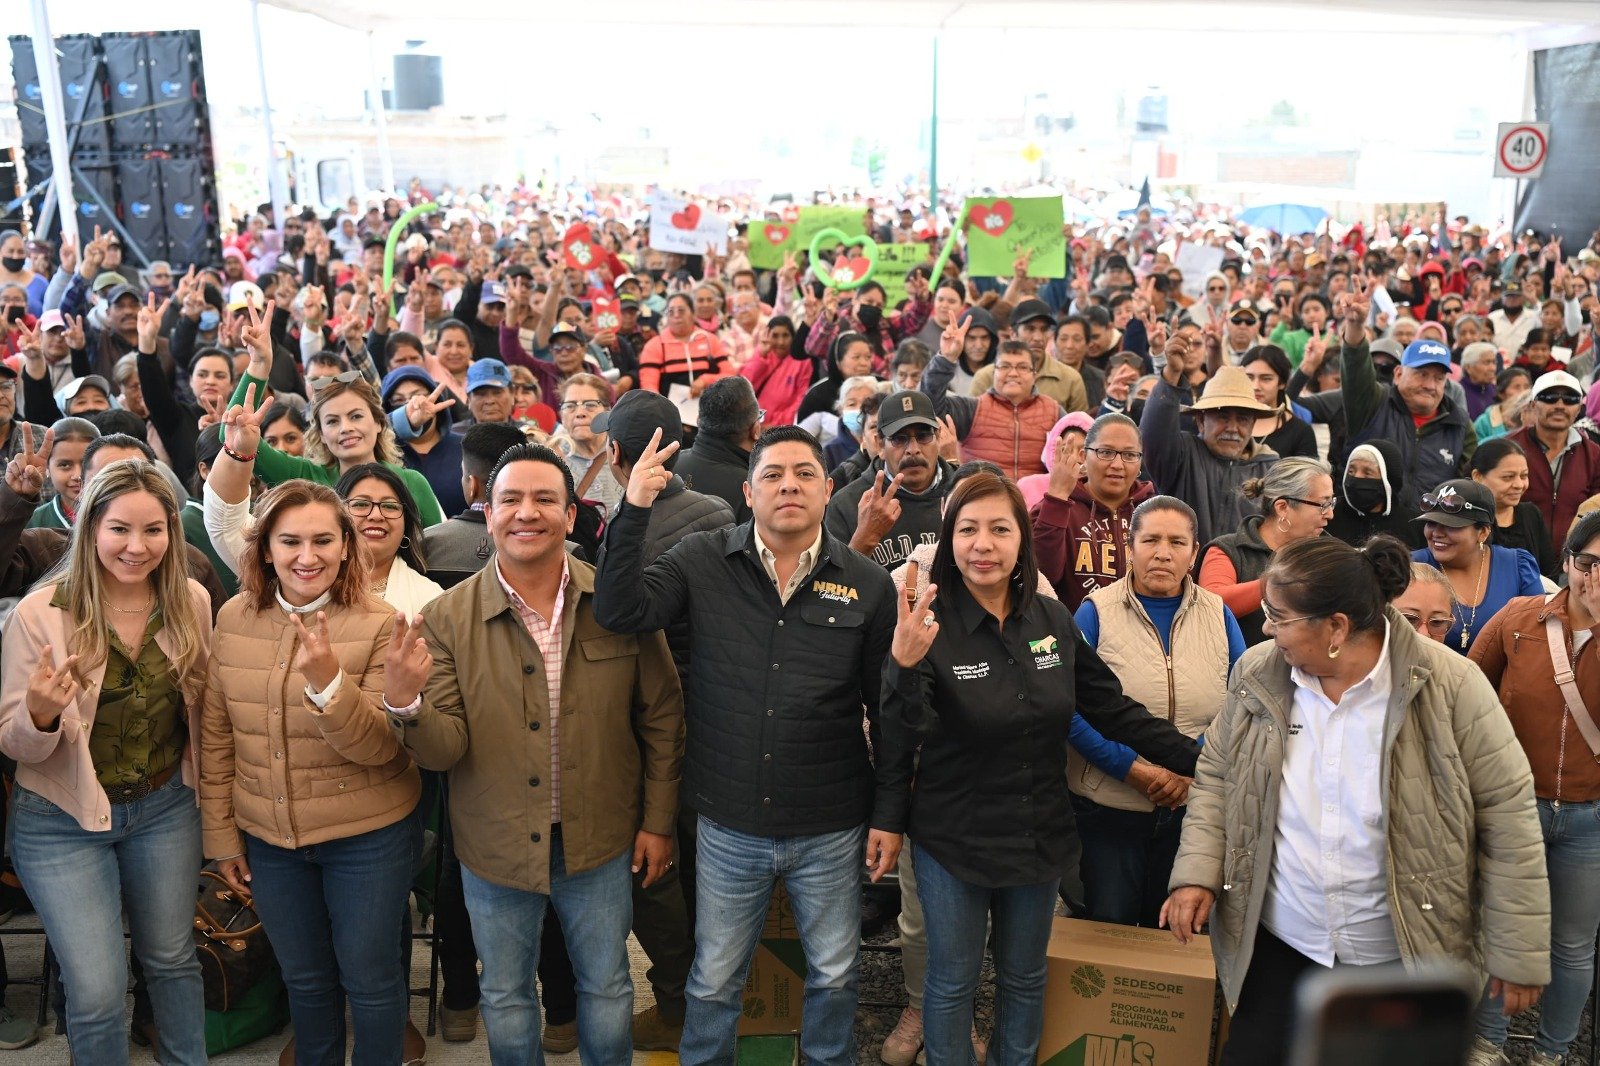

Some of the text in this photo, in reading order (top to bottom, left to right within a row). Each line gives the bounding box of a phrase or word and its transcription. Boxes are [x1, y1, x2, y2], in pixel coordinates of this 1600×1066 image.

[1512, 136, 1535, 157] 40
[812, 580, 859, 601] NRHA
[818, 589, 851, 605] Futurity
[1034, 653, 1060, 664] CHARCAS
[1113, 976, 1184, 995] SEDESORE
[1110, 1010, 1169, 1024] SEGURIDAD
[1111, 1002, 1185, 1019] PROGRAMA DE
[1109, 1017, 1177, 1033] ALIMENTARIA
